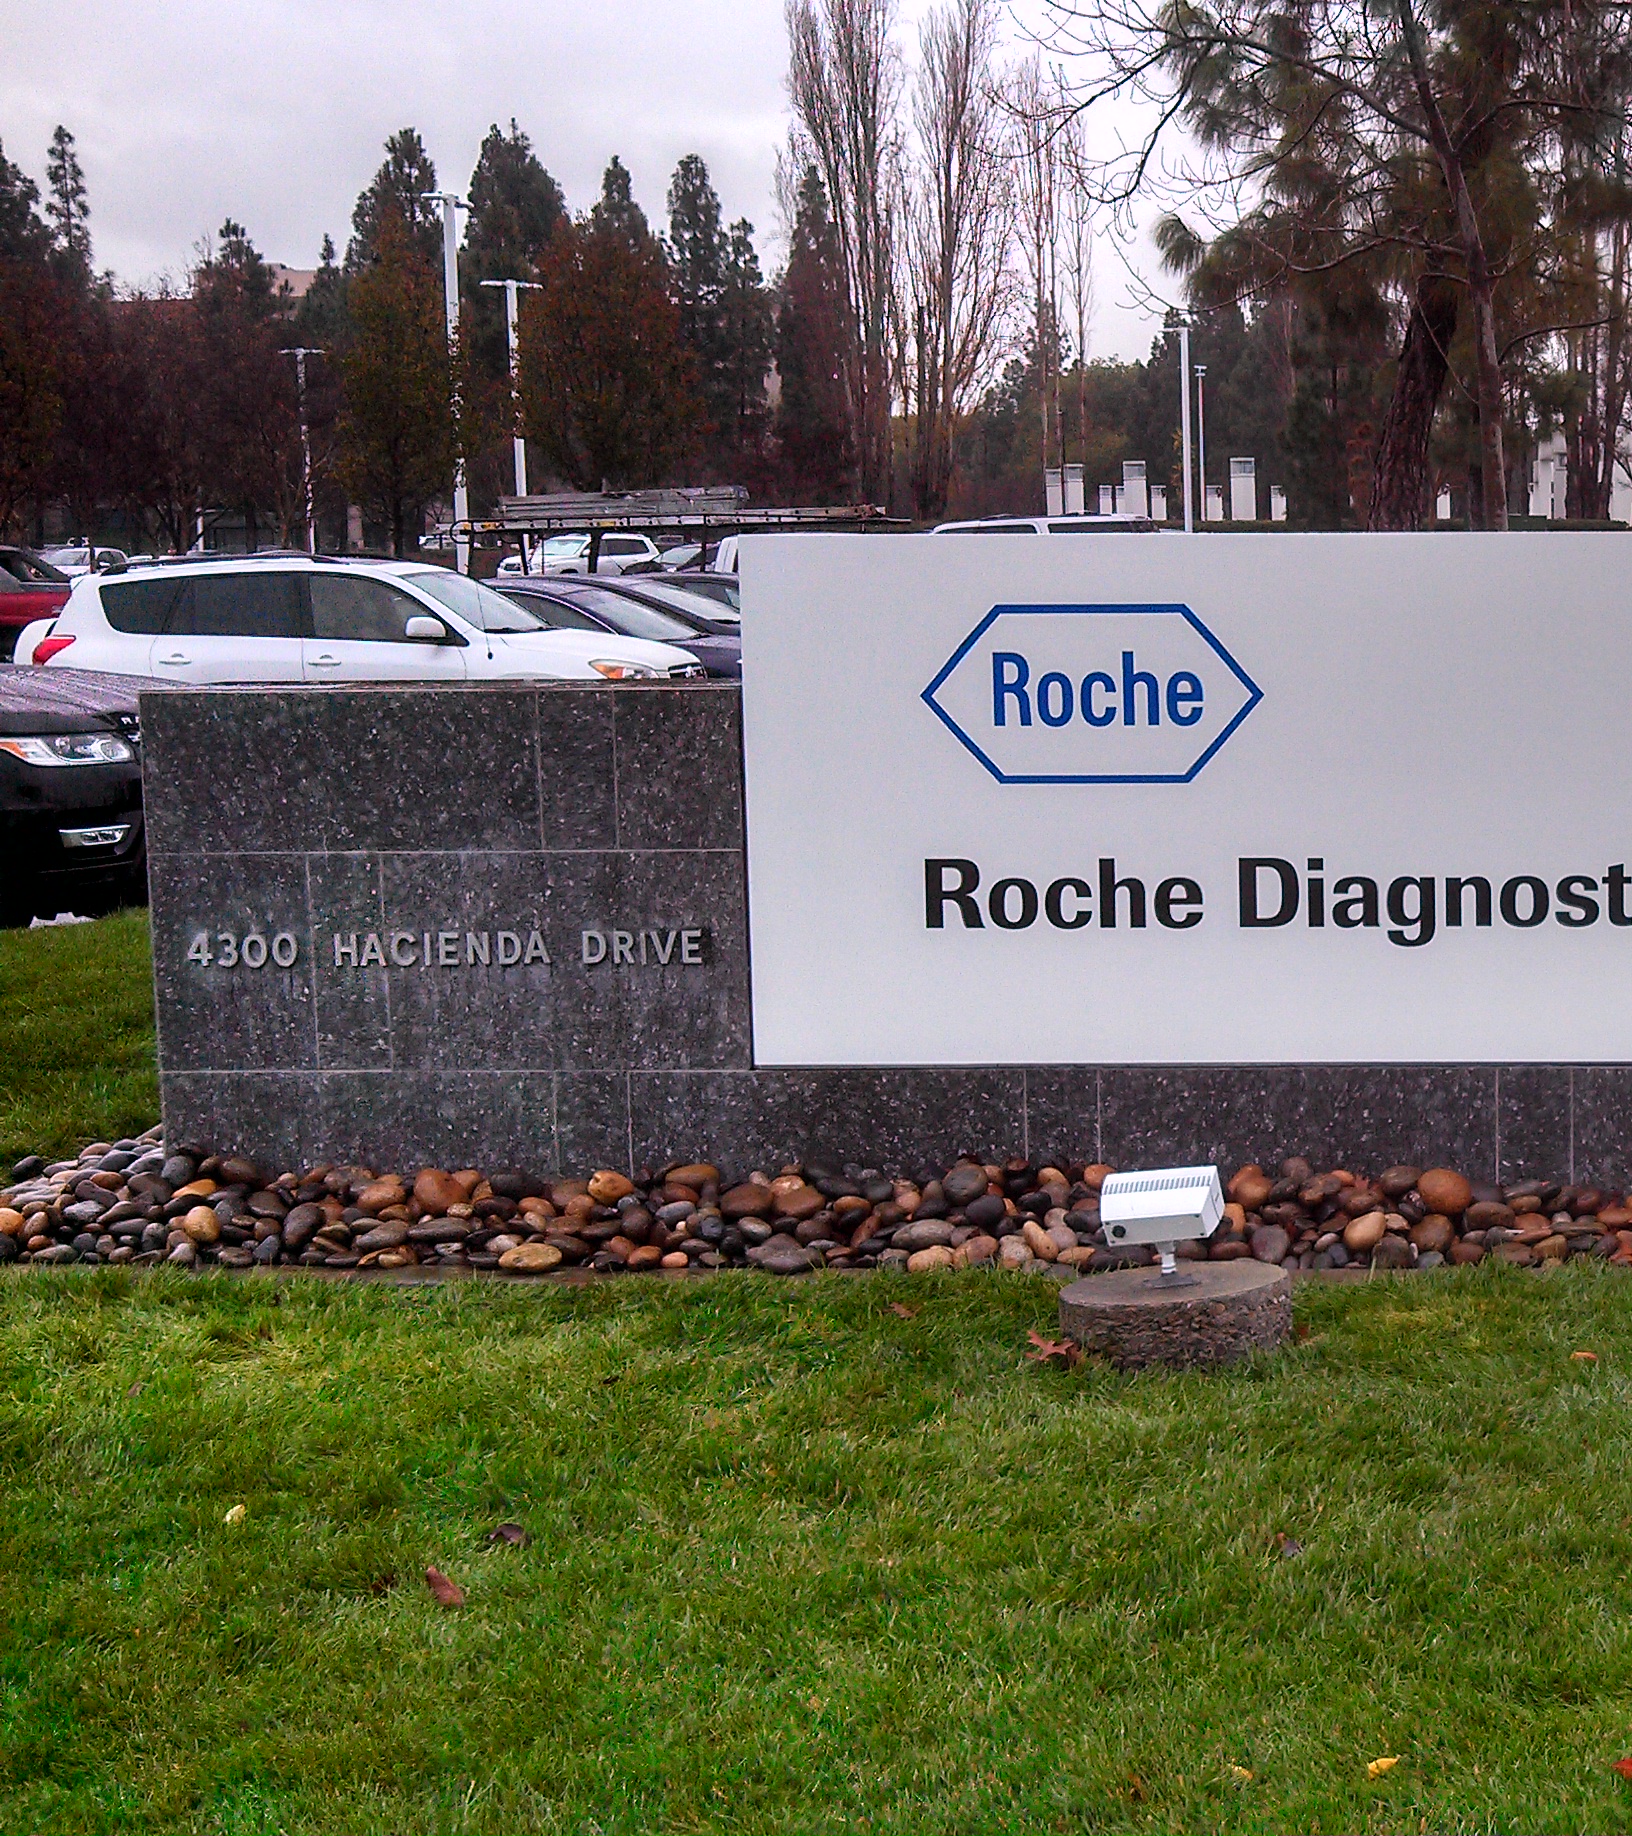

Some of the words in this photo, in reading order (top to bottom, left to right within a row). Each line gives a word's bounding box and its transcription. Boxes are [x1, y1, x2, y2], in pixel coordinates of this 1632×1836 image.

[990, 650, 1206, 728] Roche
[924, 857, 1204, 930] Roche
[187, 930, 299, 969] 4300
[333, 930, 552, 968] HACIENDA
[581, 930, 703, 966] DRIVE
